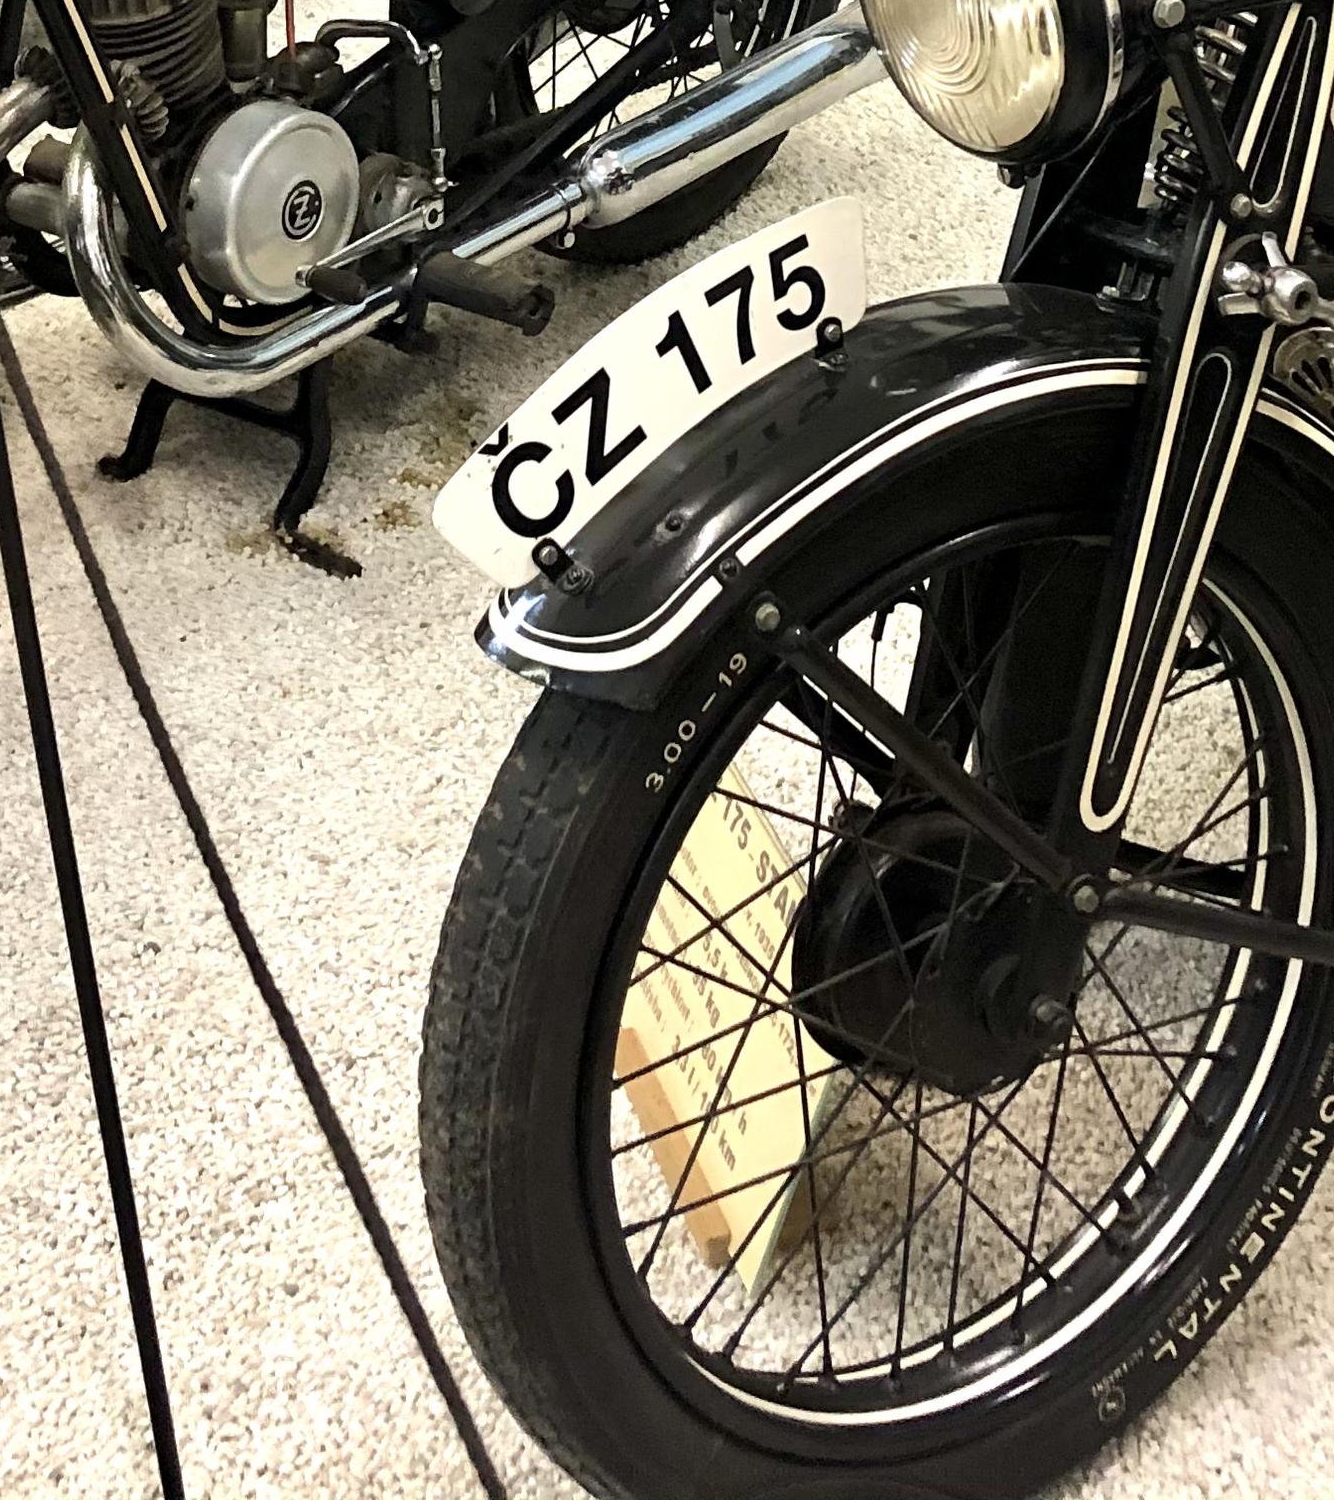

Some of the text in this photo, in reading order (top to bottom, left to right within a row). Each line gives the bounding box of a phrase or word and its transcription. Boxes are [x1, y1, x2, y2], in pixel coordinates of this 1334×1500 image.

[478, 233, 826, 539] ČZ 175
[704, 991, 722, 1029] kg
[716, 1133, 740, 1172] km
